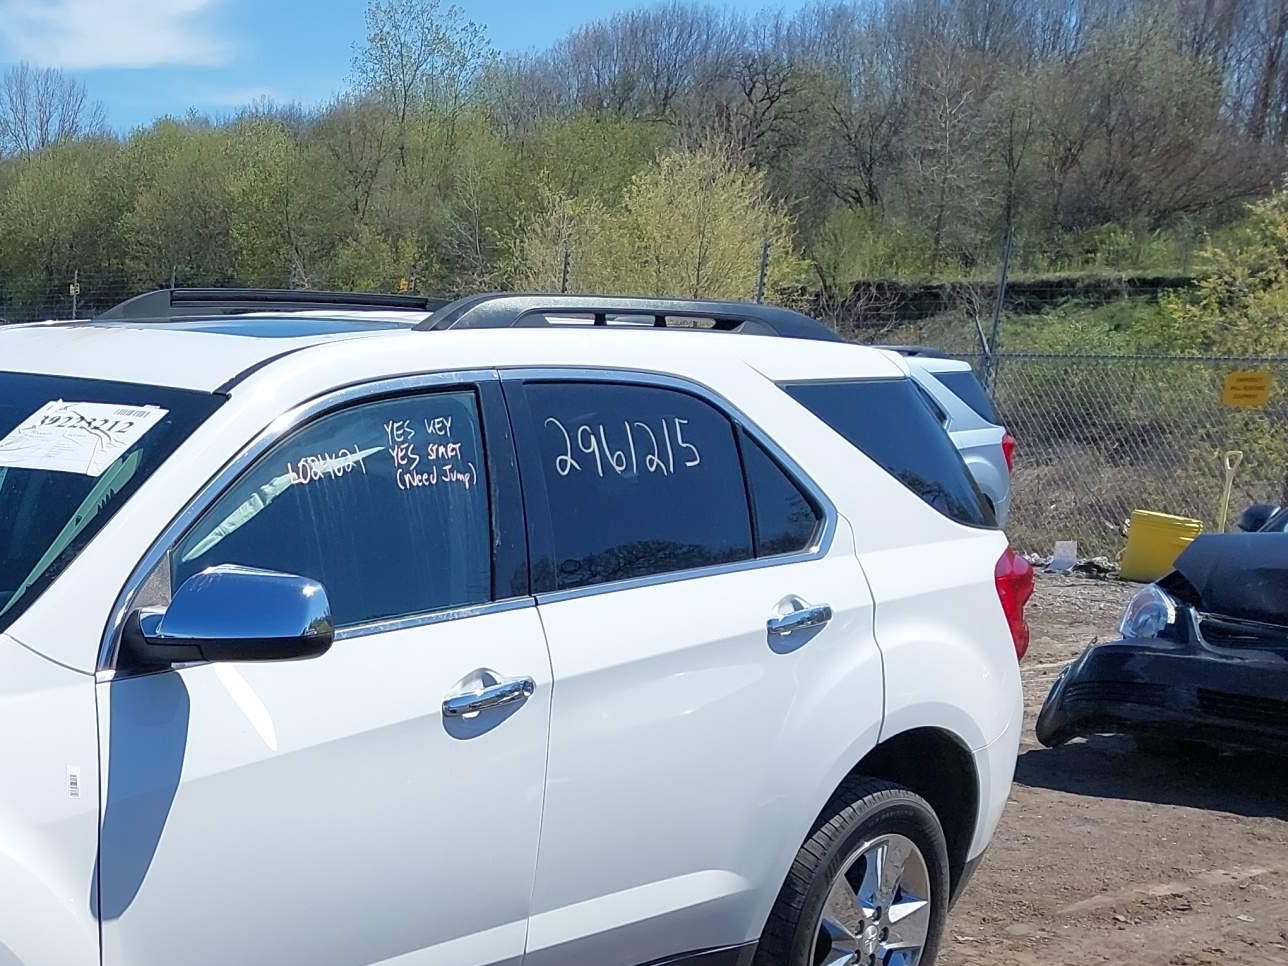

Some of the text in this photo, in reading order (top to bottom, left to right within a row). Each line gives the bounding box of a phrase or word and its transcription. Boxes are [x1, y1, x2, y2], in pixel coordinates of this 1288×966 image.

[383, 419, 415, 444] YES
[389, 443, 420, 470] YES
[544, 417, 701, 478] 2961215
